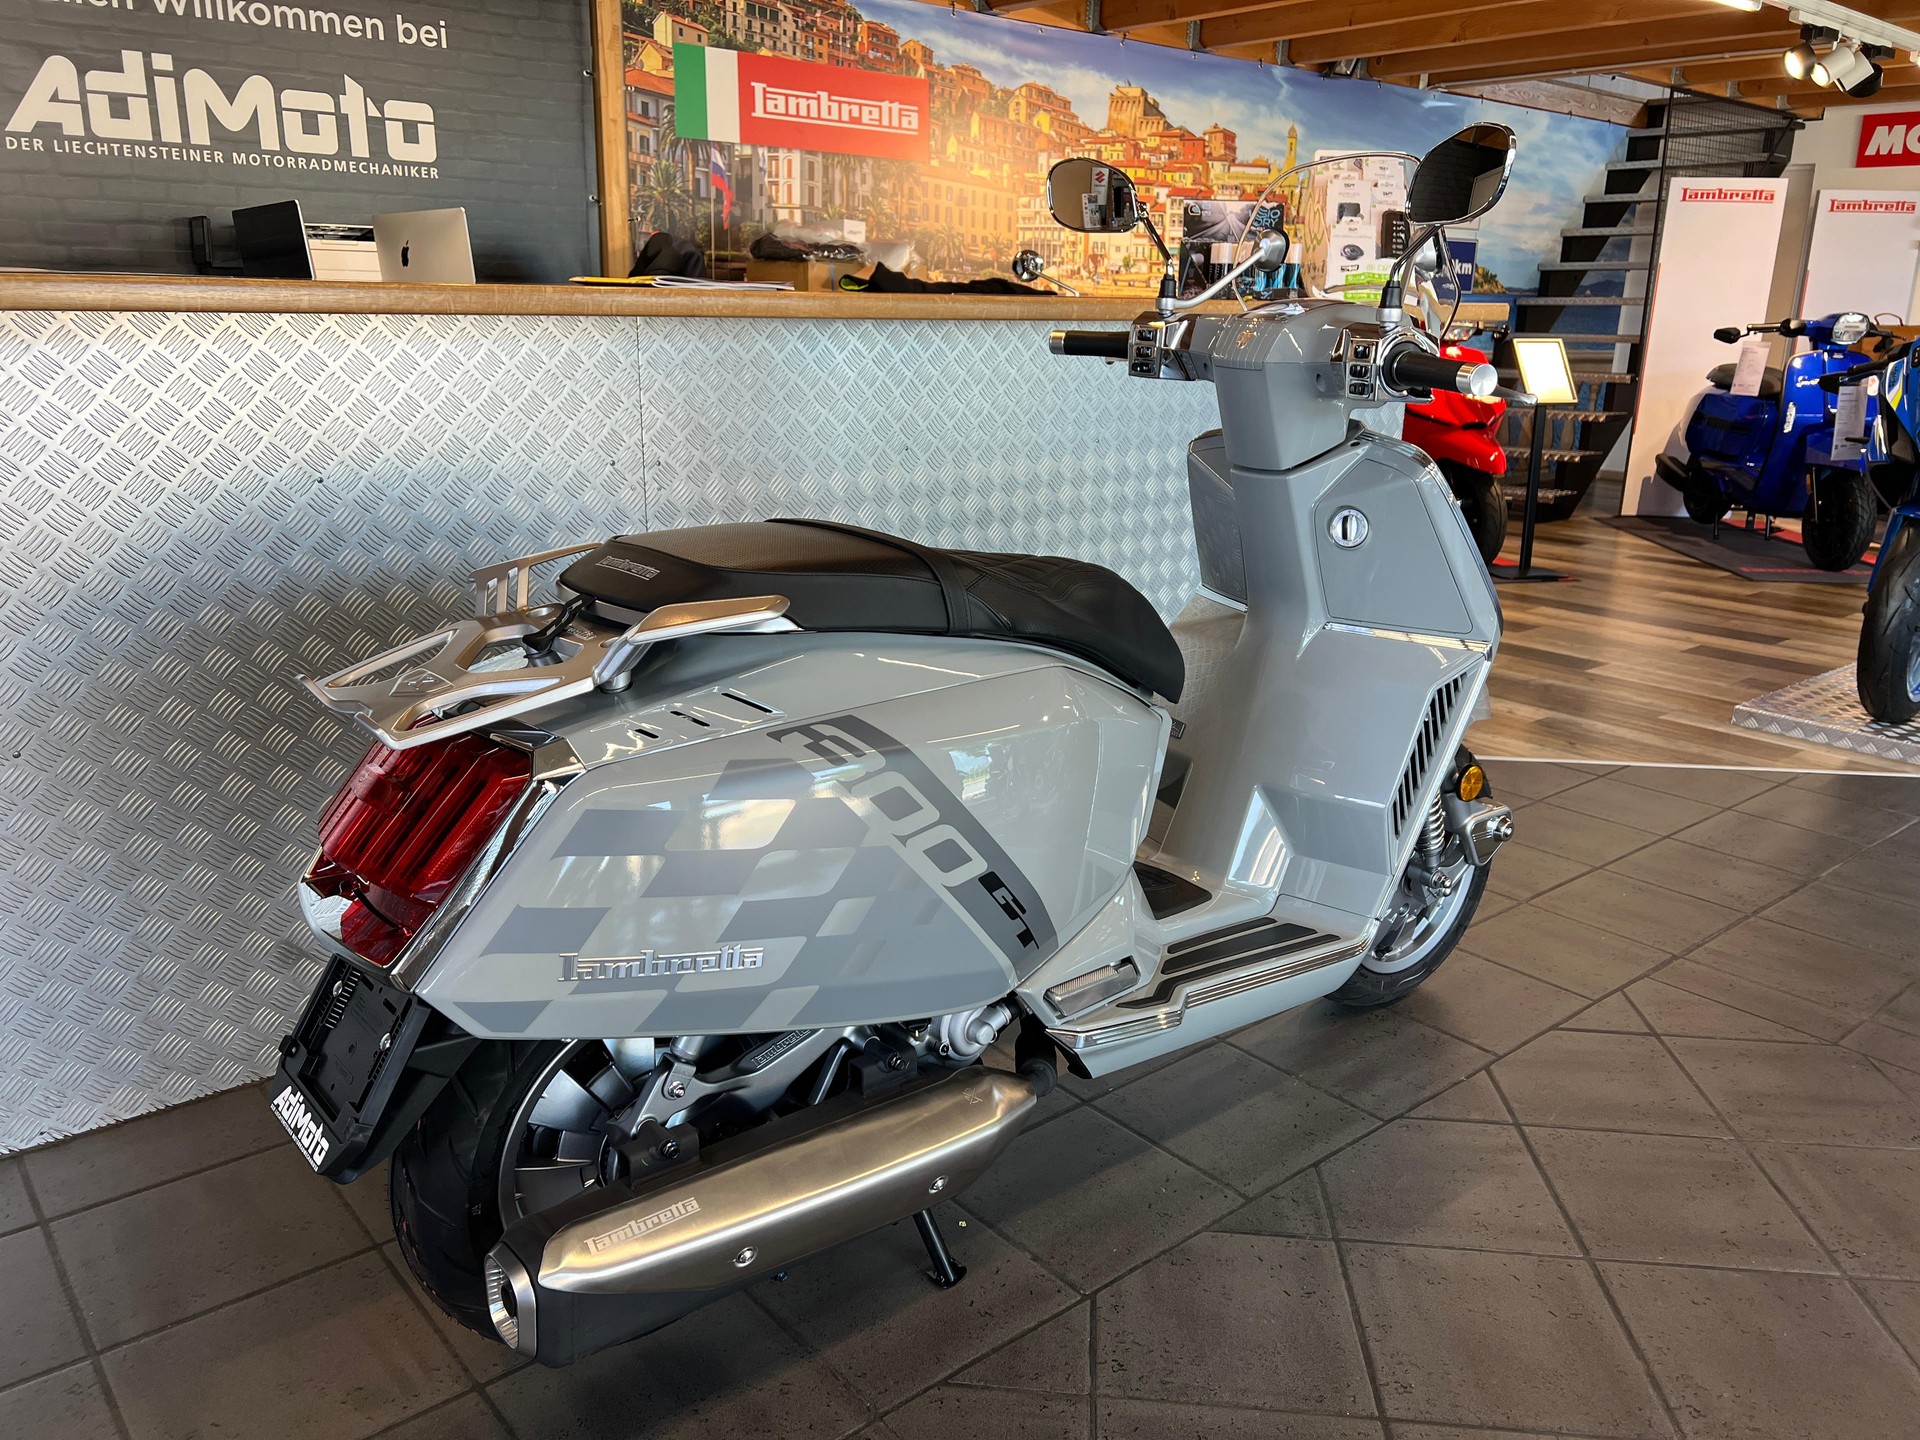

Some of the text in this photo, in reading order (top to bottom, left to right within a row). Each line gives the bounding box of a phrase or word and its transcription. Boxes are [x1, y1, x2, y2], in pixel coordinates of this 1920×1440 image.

[396, 15, 448, 49] bei
[4, 49, 437, 163] AdiMoto
[750, 81, 919, 136] Lambretta
[5, 136, 440, 180] DER LIECHTENSTEINER MOTORRADMECHANIKER
[1680, 187, 1776, 204] Lambretta
[1828, 198, 1917, 215] Lambretta
[595, 555, 661, 581] Lambretta
[557, 943, 765, 982] Lambretta
[272, 1085, 330, 1166] AdiMoto
[583, 1196, 701, 1257] Lambretta
